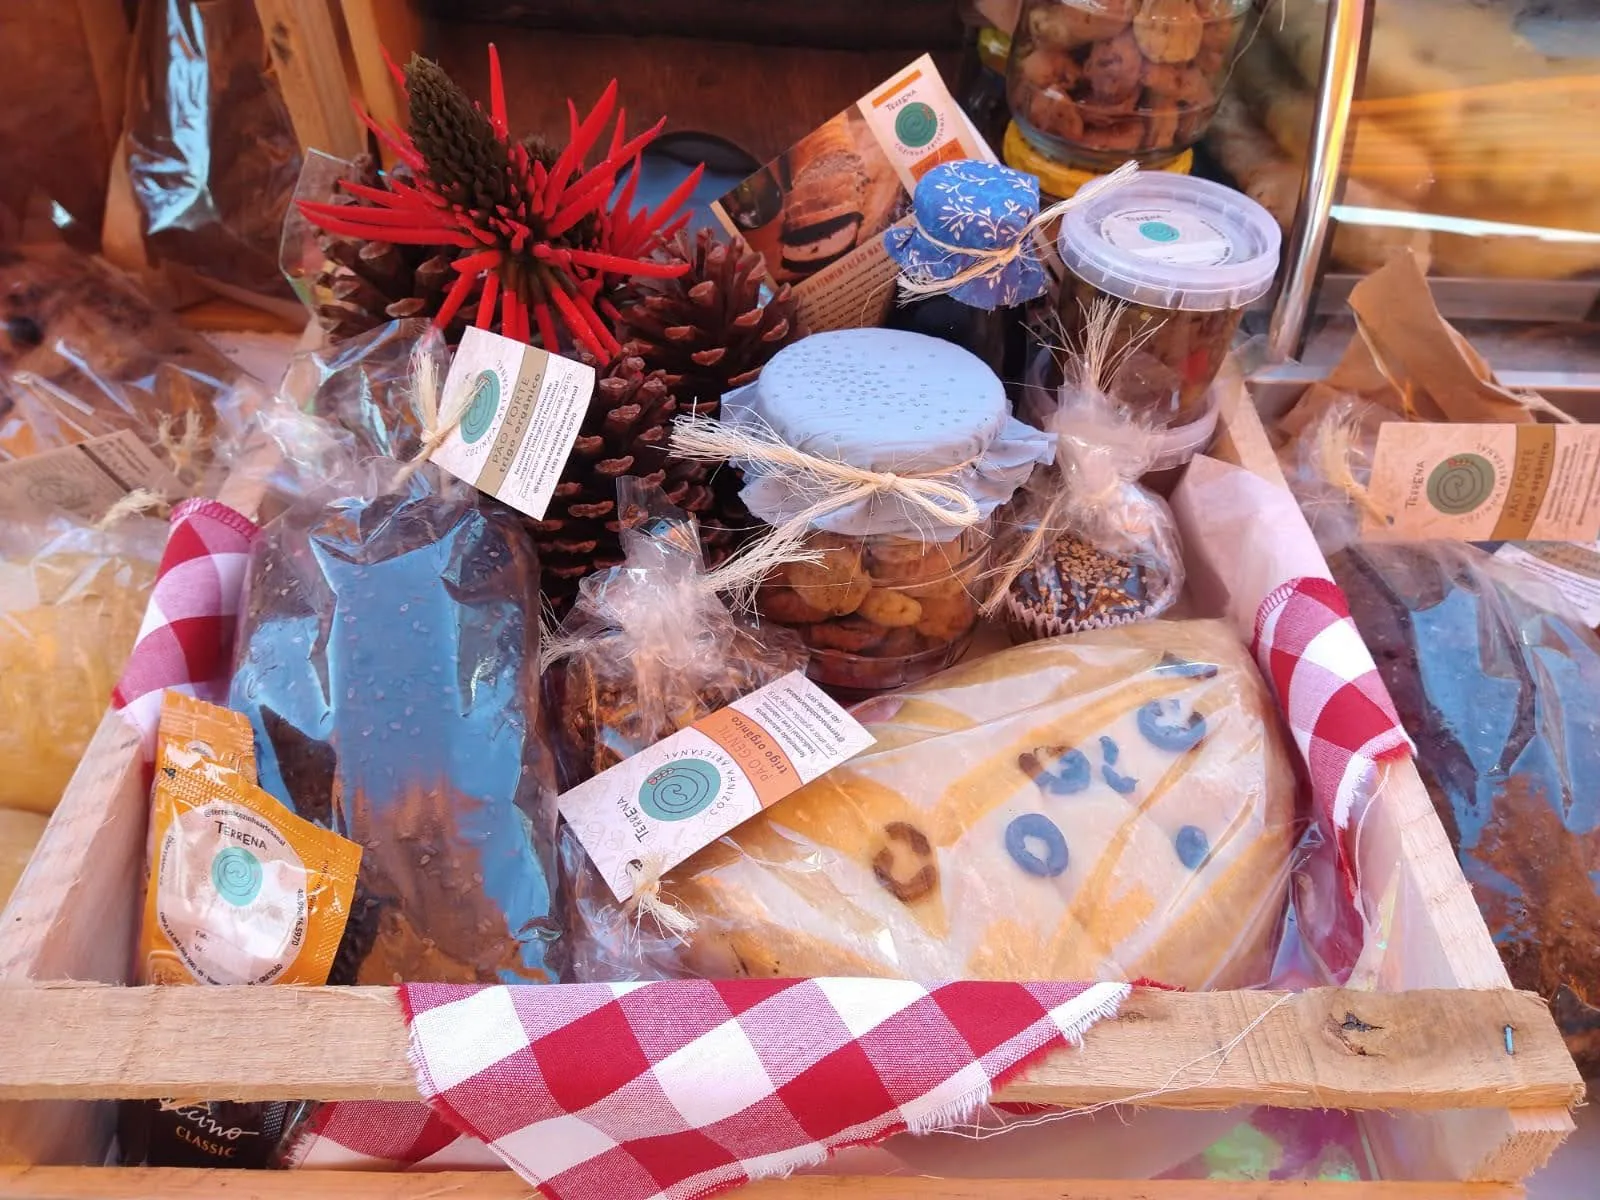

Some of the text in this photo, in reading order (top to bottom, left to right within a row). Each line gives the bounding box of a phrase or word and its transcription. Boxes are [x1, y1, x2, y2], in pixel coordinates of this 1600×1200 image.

[499, 373, 541, 472] trigo orgânico
[505, 377, 529, 425] FORTE
[1405, 461, 1424, 509] TERRENA
[716, 725, 752, 760] GENTIL
[731, 715, 787, 773] trigo orgânico
[664, 749, 735, 815] COZINHA ARTESANAL
[215, 820, 268, 850] TERRENA
[617, 796, 648, 843] TERRENA
[175, 1125, 237, 1157] CLASSIC
